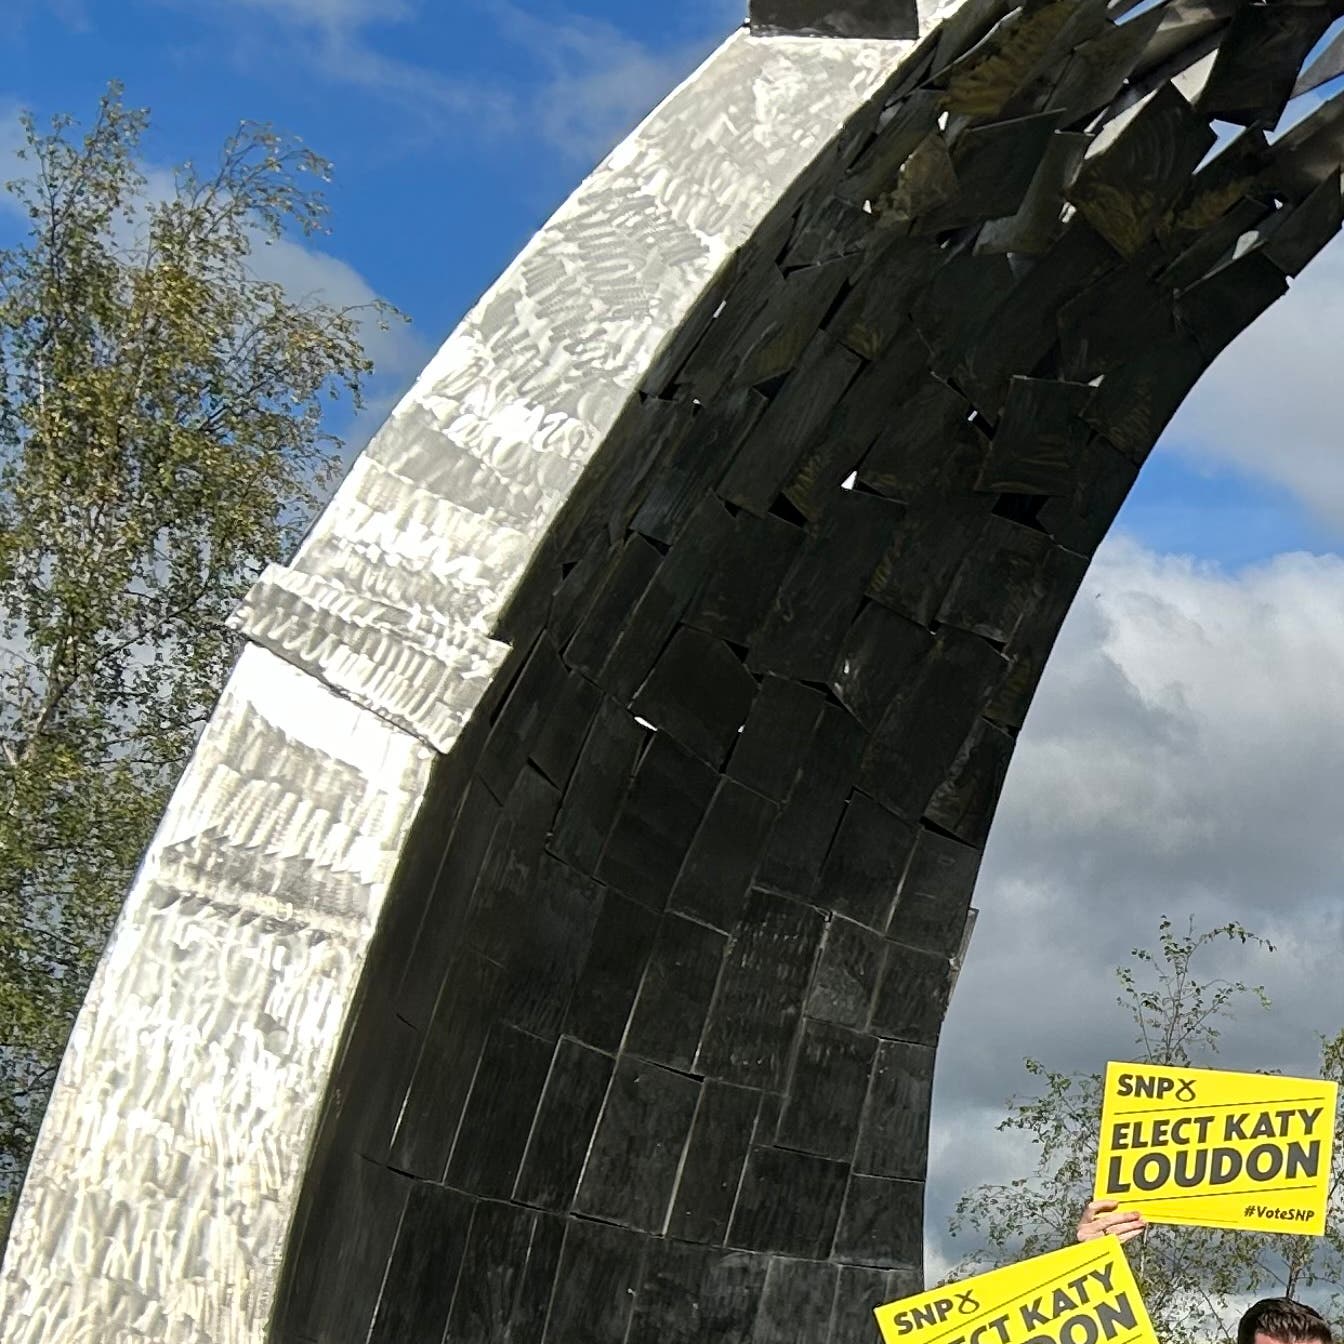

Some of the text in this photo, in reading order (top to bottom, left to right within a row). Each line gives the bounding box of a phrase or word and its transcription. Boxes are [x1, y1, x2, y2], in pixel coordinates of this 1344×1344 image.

[1117, 1074, 1174, 1099] SNP
[1111, 1107, 1324, 1150] ELECT KATY
[1107, 1140, 1321, 1194] LOUDON
[1244, 1205, 1315, 1221] #VoteSNP
[894, 1298, 954, 1335] SNP
[1020, 1261, 1114, 1332] KATY
